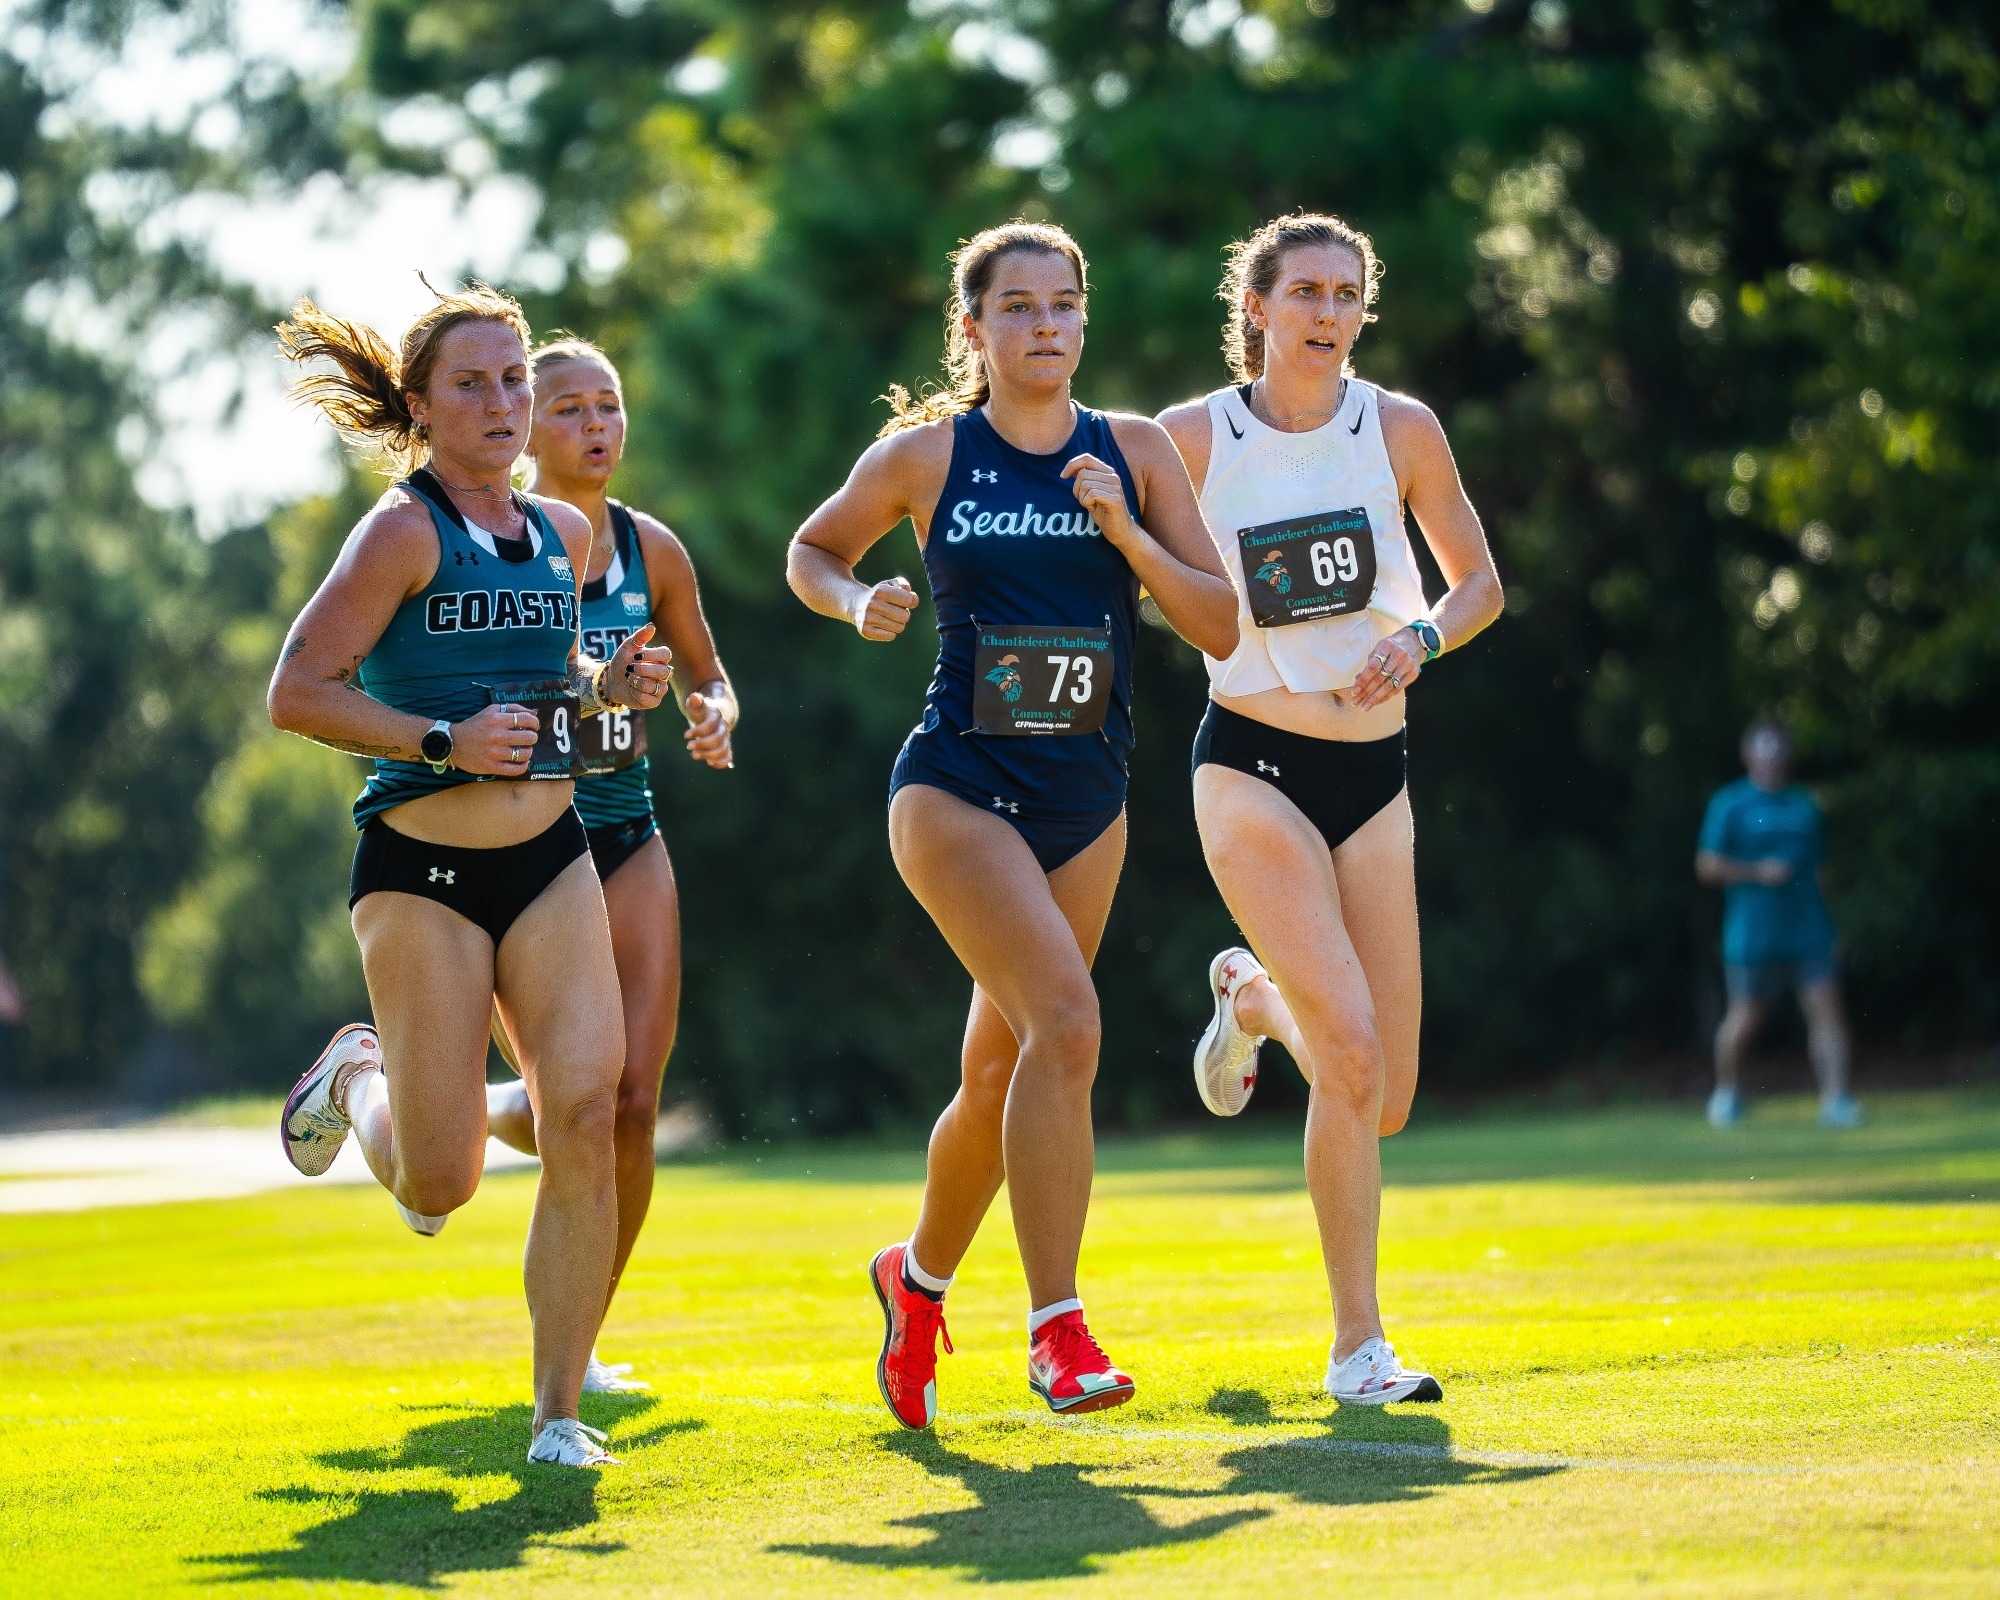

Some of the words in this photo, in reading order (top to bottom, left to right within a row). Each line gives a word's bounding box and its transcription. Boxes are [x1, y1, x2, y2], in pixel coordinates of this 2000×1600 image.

[947, 500, 1102, 544] Seahaw
[1244, 529, 1309, 548] Chanticleer
[1310, 518, 1365, 536] Challenge
[1310, 537, 1359, 586] 69
[426, 589, 578, 634] COAST
[1333, 588, 1348, 599] SC
[981, 635, 1051, 648] Chanticleer
[1053, 636, 1109, 651] Challenge
[1047, 655, 1094, 703] 73
[553, 706, 571, 753] 9
[597, 709, 632, 751] 15
[1060, 709, 1075, 719] SC
